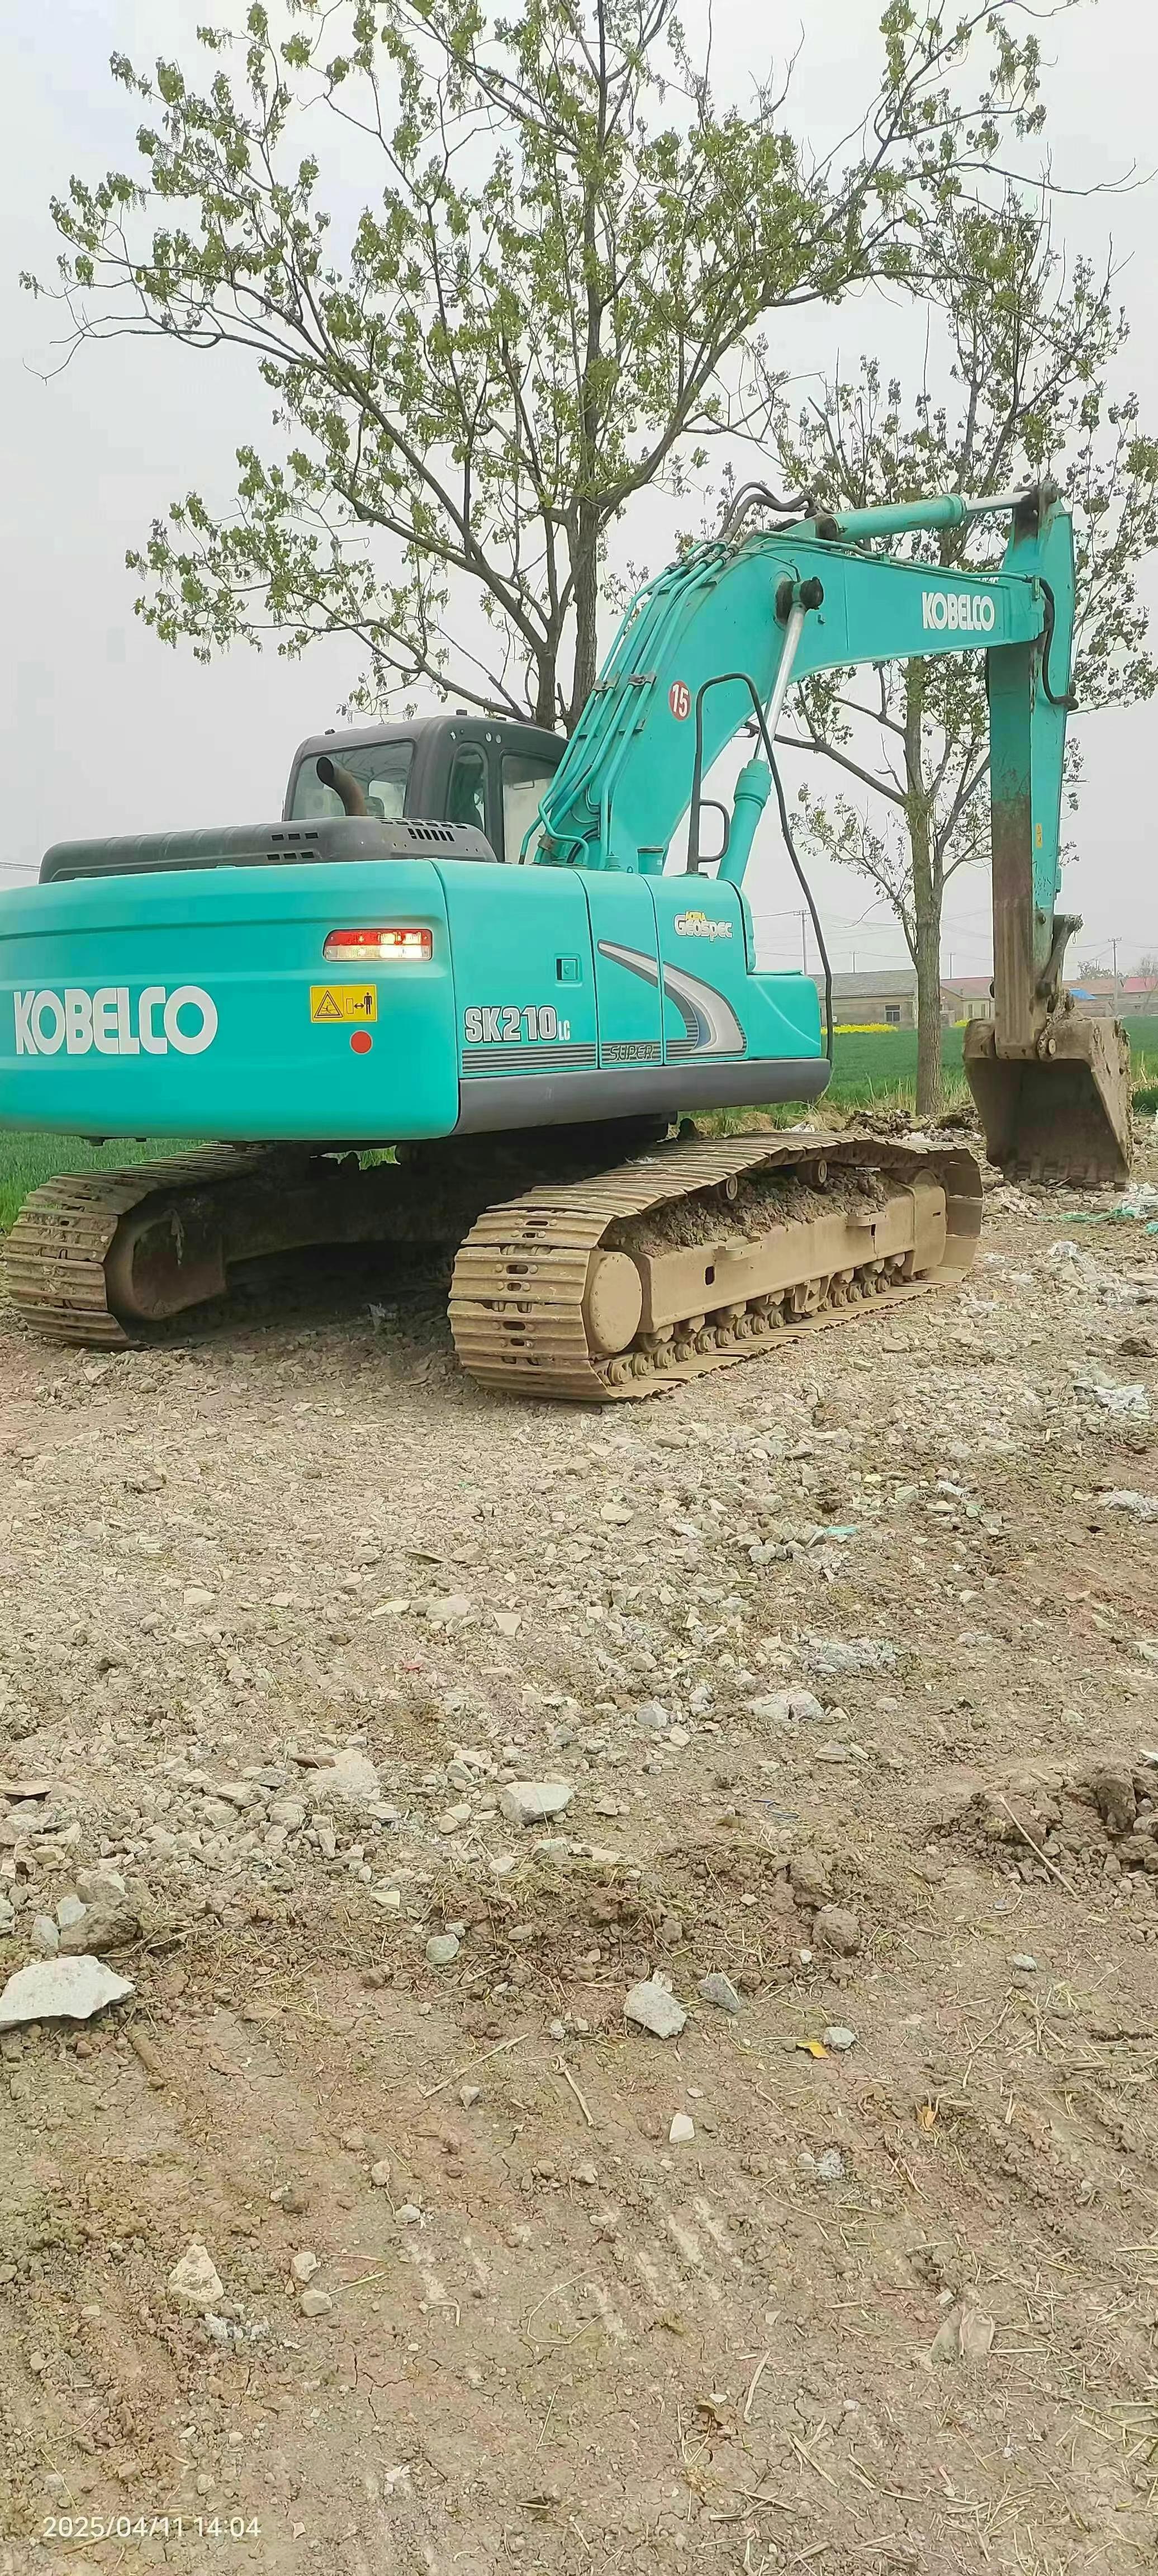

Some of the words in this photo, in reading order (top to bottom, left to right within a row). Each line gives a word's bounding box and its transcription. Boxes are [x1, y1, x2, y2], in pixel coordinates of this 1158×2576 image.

[922, 591, 995, 631] KOBELCO
[672, 684, 689, 717] 15
[13, 985, 218, 1054] KOBELCO
[610, 1045, 653, 1061] SUPER
